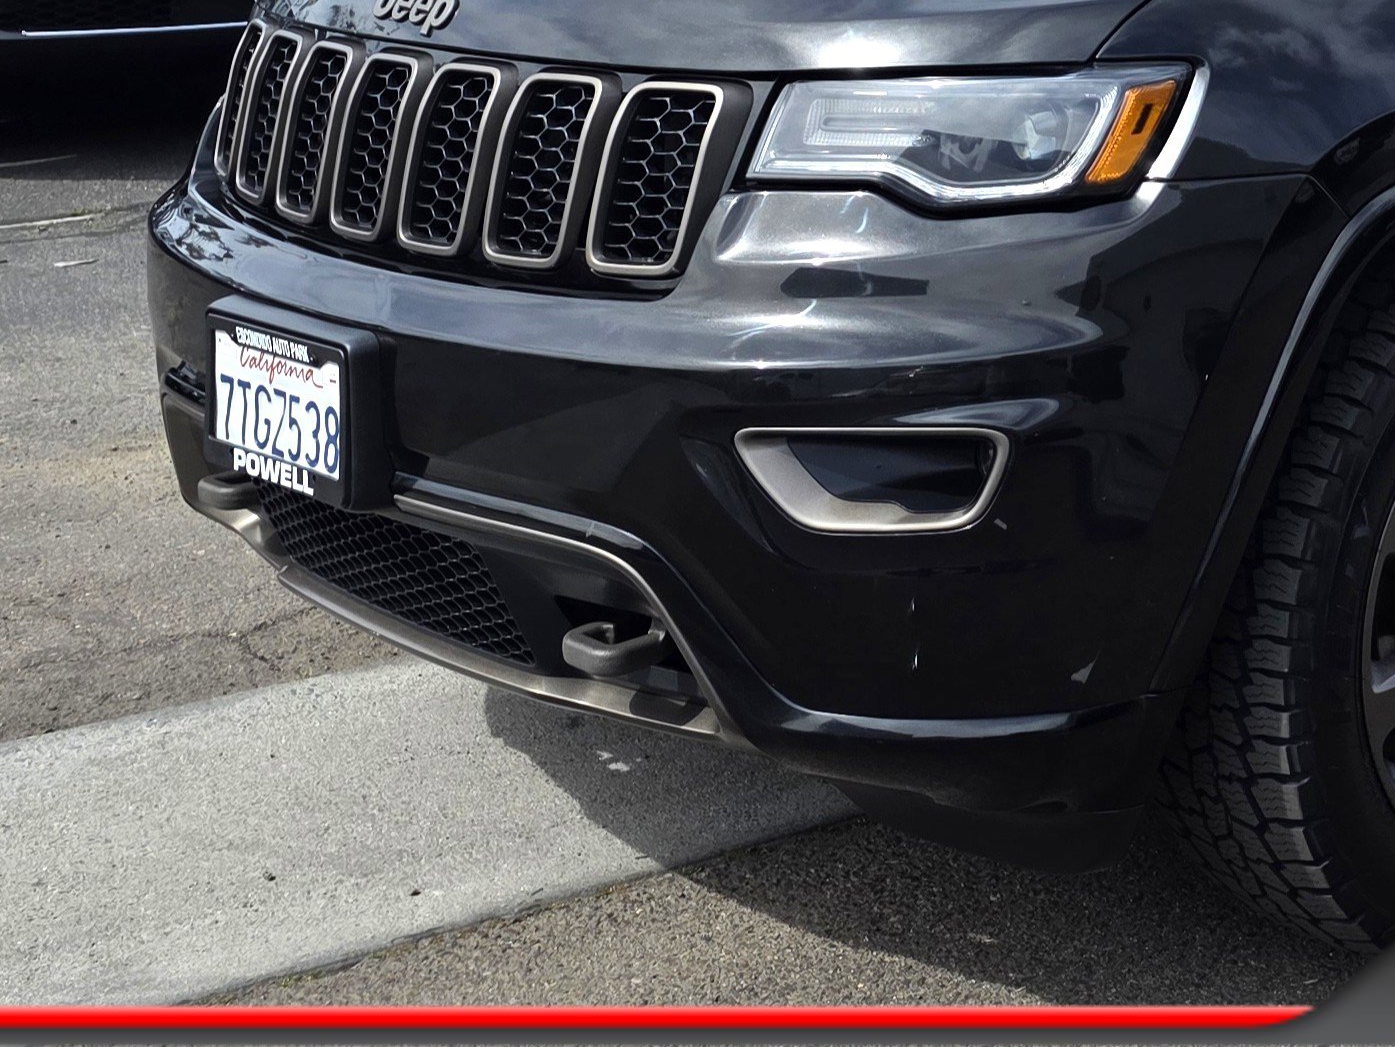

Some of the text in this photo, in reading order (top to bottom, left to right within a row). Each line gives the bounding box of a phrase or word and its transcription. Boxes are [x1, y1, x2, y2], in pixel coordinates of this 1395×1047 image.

[235, 326, 310, 363] ESCONDIDO AUTO PARK
[240, 347, 324, 388] California
[220, 373, 340, 474] 7TGZ538
[233, 447, 315, 496] POWELL
